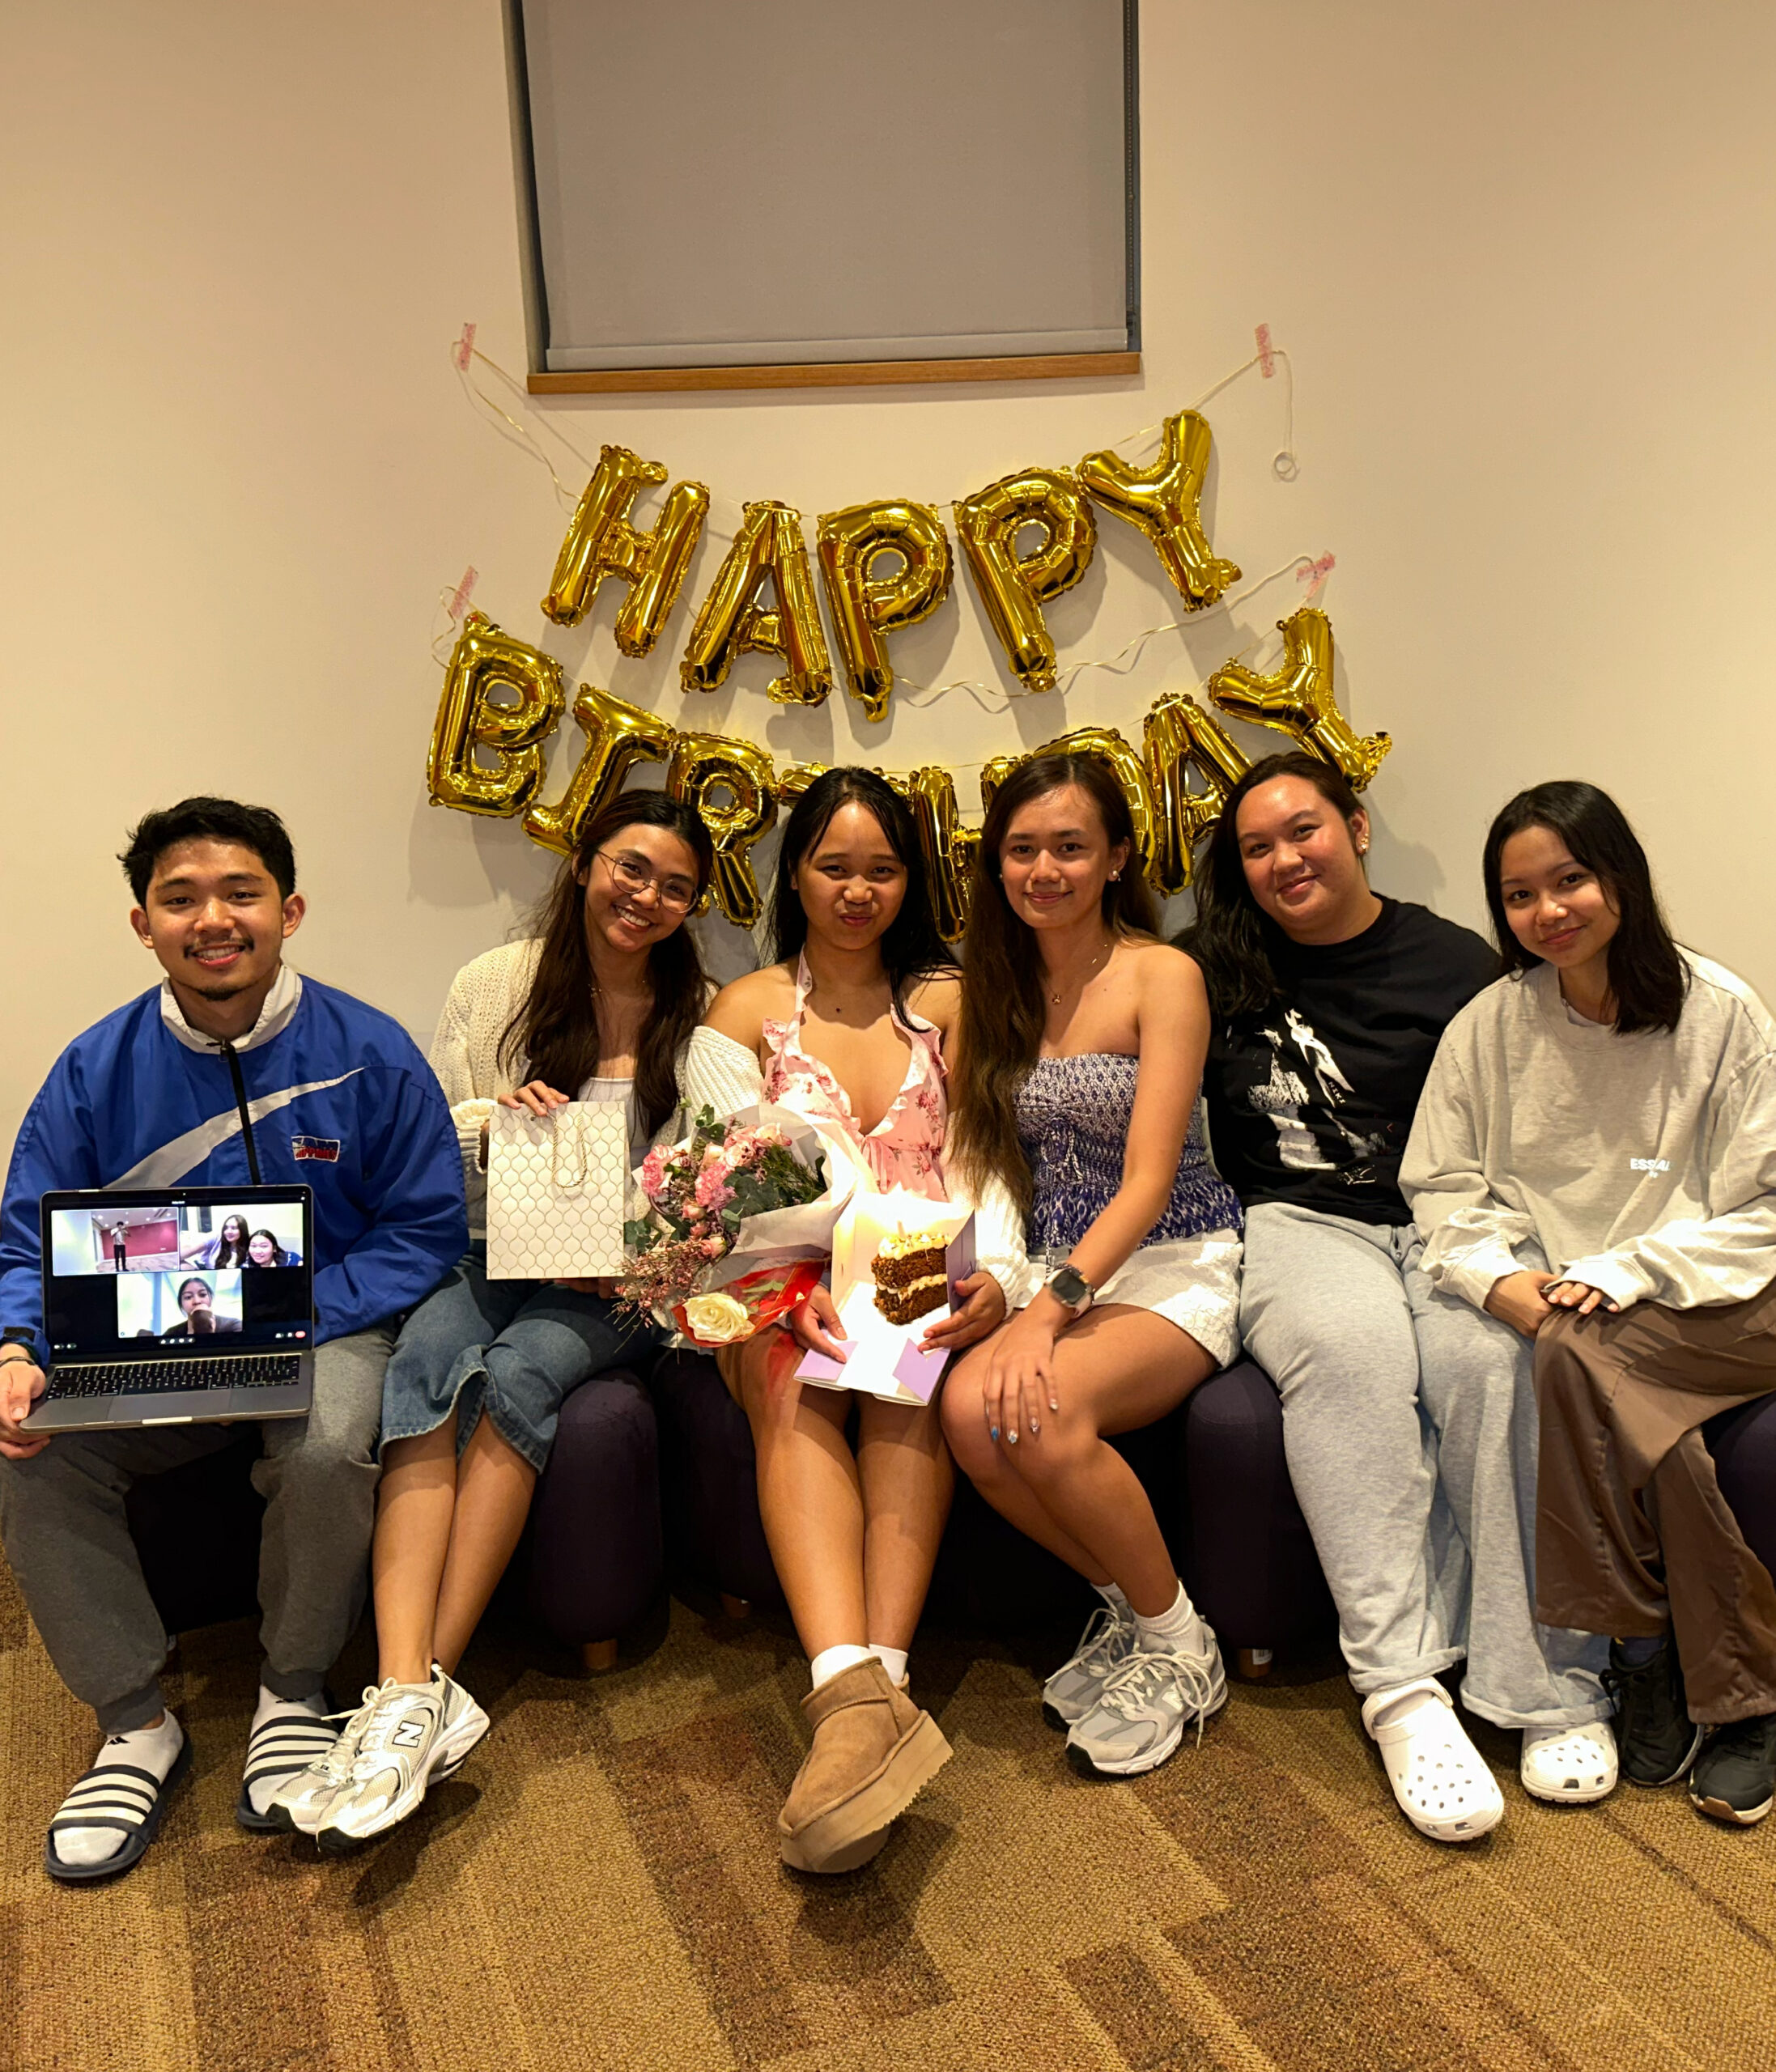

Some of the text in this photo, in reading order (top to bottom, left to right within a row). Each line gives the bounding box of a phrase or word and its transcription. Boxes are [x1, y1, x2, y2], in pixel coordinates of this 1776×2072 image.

[541, 410, 1241, 722] HAPPY
[427, 608, 1393, 944] BIRHAY
[392, 1720, 425, 1747] N
